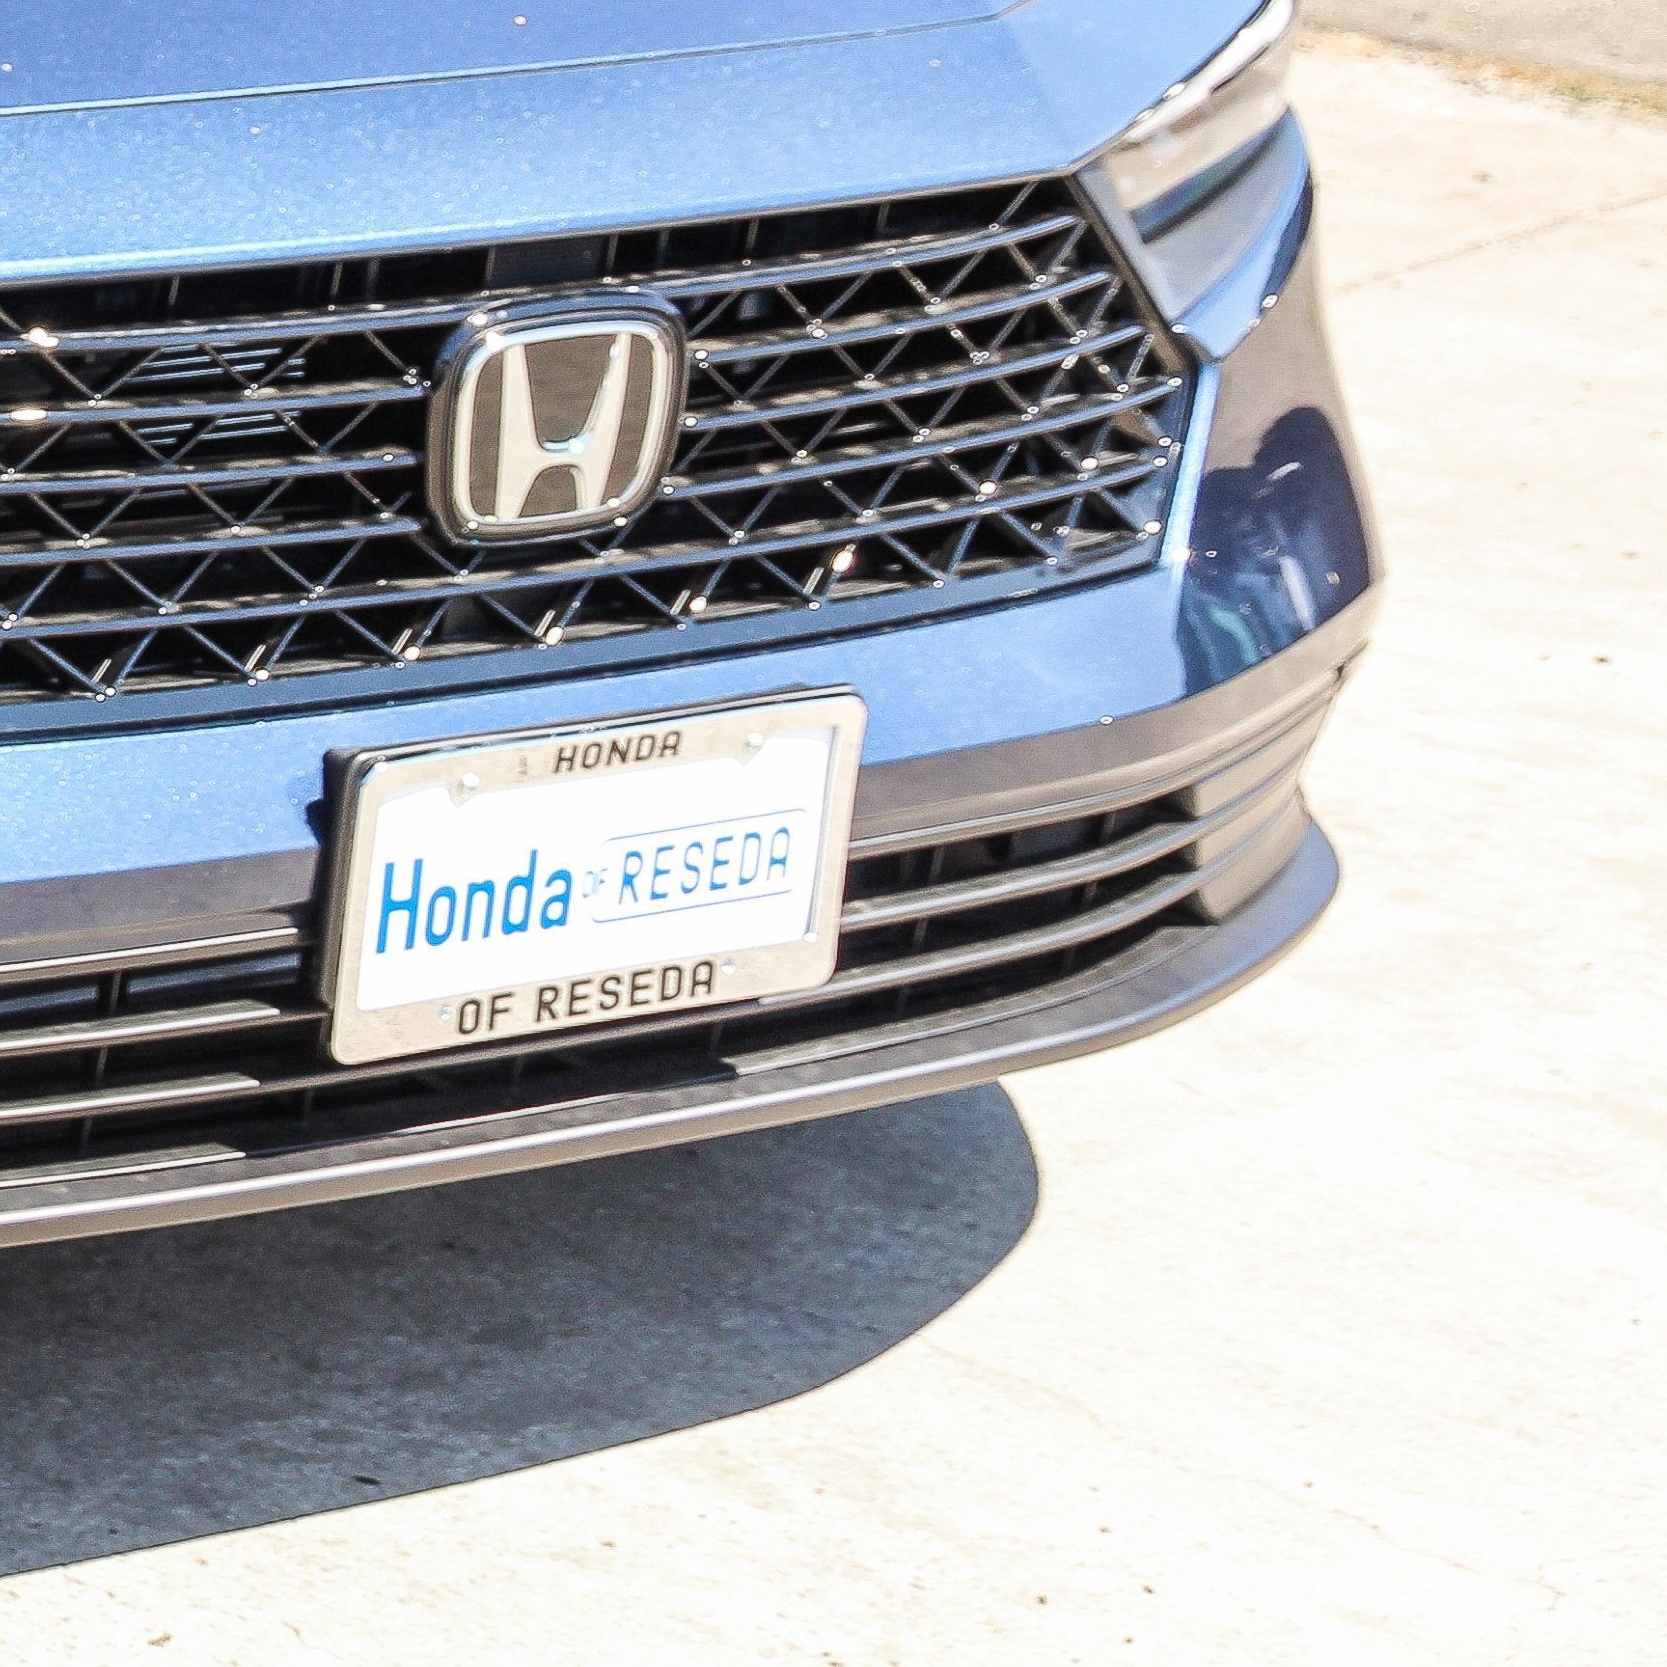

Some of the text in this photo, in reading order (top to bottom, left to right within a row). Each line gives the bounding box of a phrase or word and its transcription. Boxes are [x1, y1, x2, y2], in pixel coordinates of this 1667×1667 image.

[552, 729, 683, 774] HONDA
[375, 848, 573, 955] Honda
[618, 826, 791, 906] RESEDA
[457, 959, 715, 1035] OF RESEDA
